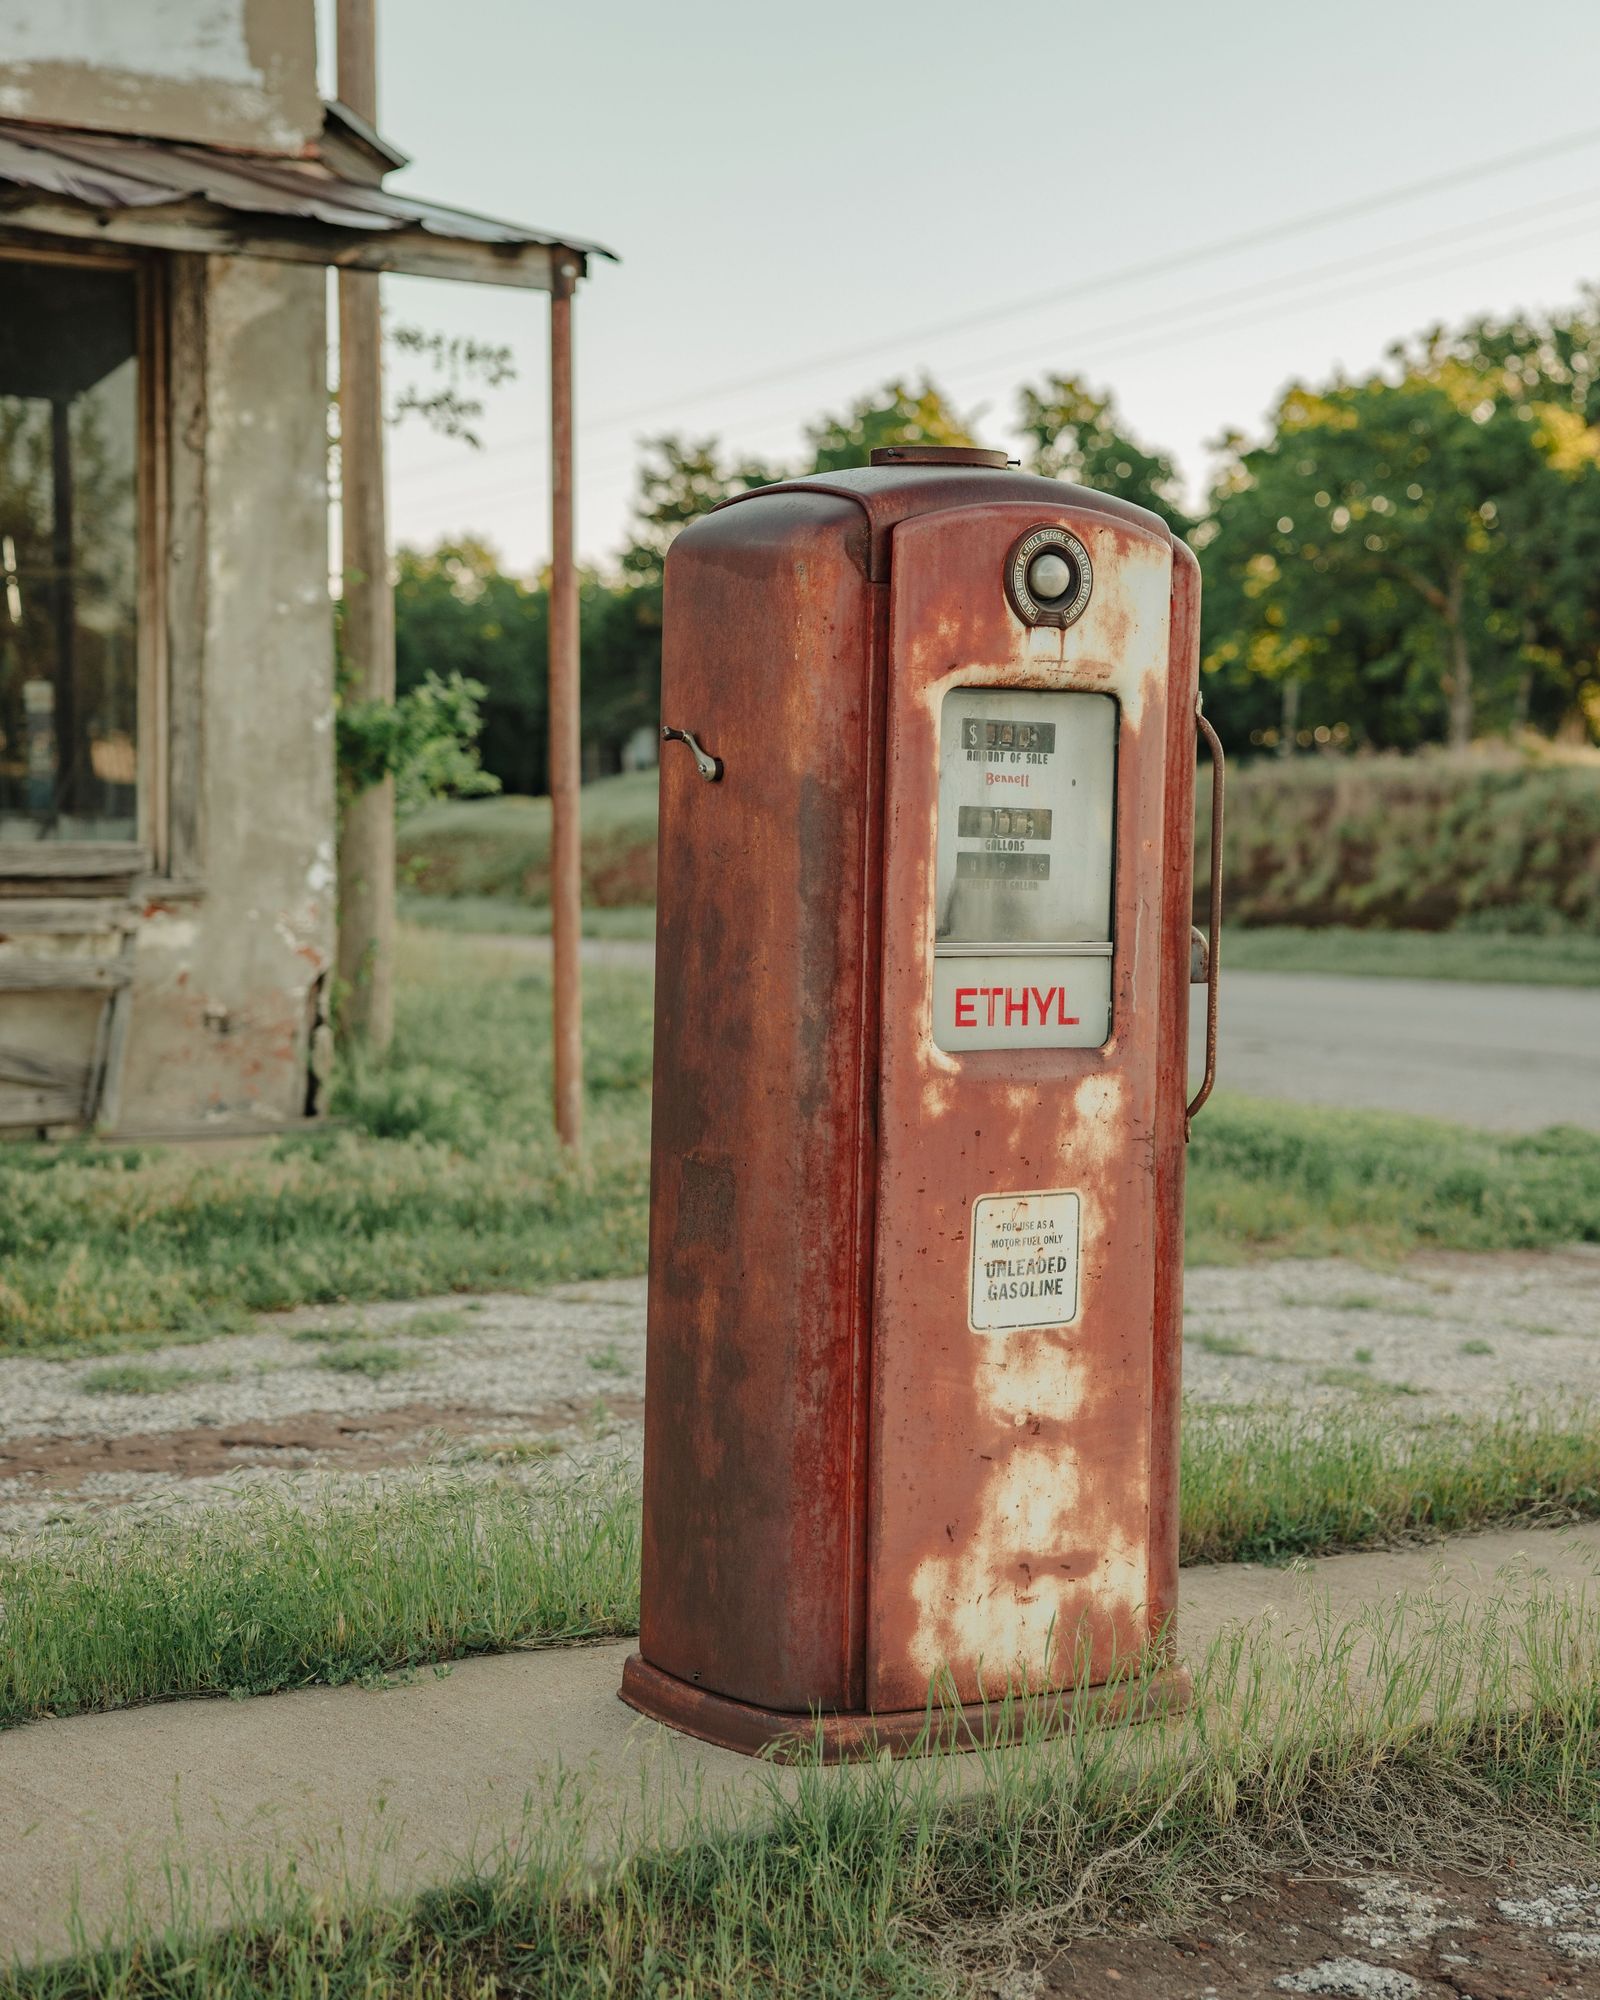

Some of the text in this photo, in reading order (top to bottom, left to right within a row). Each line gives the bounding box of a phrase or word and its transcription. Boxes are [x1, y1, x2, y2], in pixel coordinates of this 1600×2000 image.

[1040, 532, 1066, 540] BEFORE
[1024, 537, 1040, 552] FULL
[1068, 540, 1080, 552] AND
[1018, 554, 1026, 566] BE
[1080, 554, 1090, 582] AFTER
[1017, 590, 1034, 614] GLASS
[1070, 583, 1090, 618] DELIVERY
[966, 750, 1048, 764] AMOUNT OF SALE
[986, 772, 1030, 788] Bennett
[985, 840, 1024, 852] GALLONS
[955, 986, 1080, 1027] ETHYL
[1002, 1220, 1054, 1232] FOR USE AS A
[992, 1234, 1063, 1248] MOTOR FUEL ONLY
[986, 1256, 1067, 1278] UNLEADED
[988, 1278, 1064, 1300] GASOLINE
